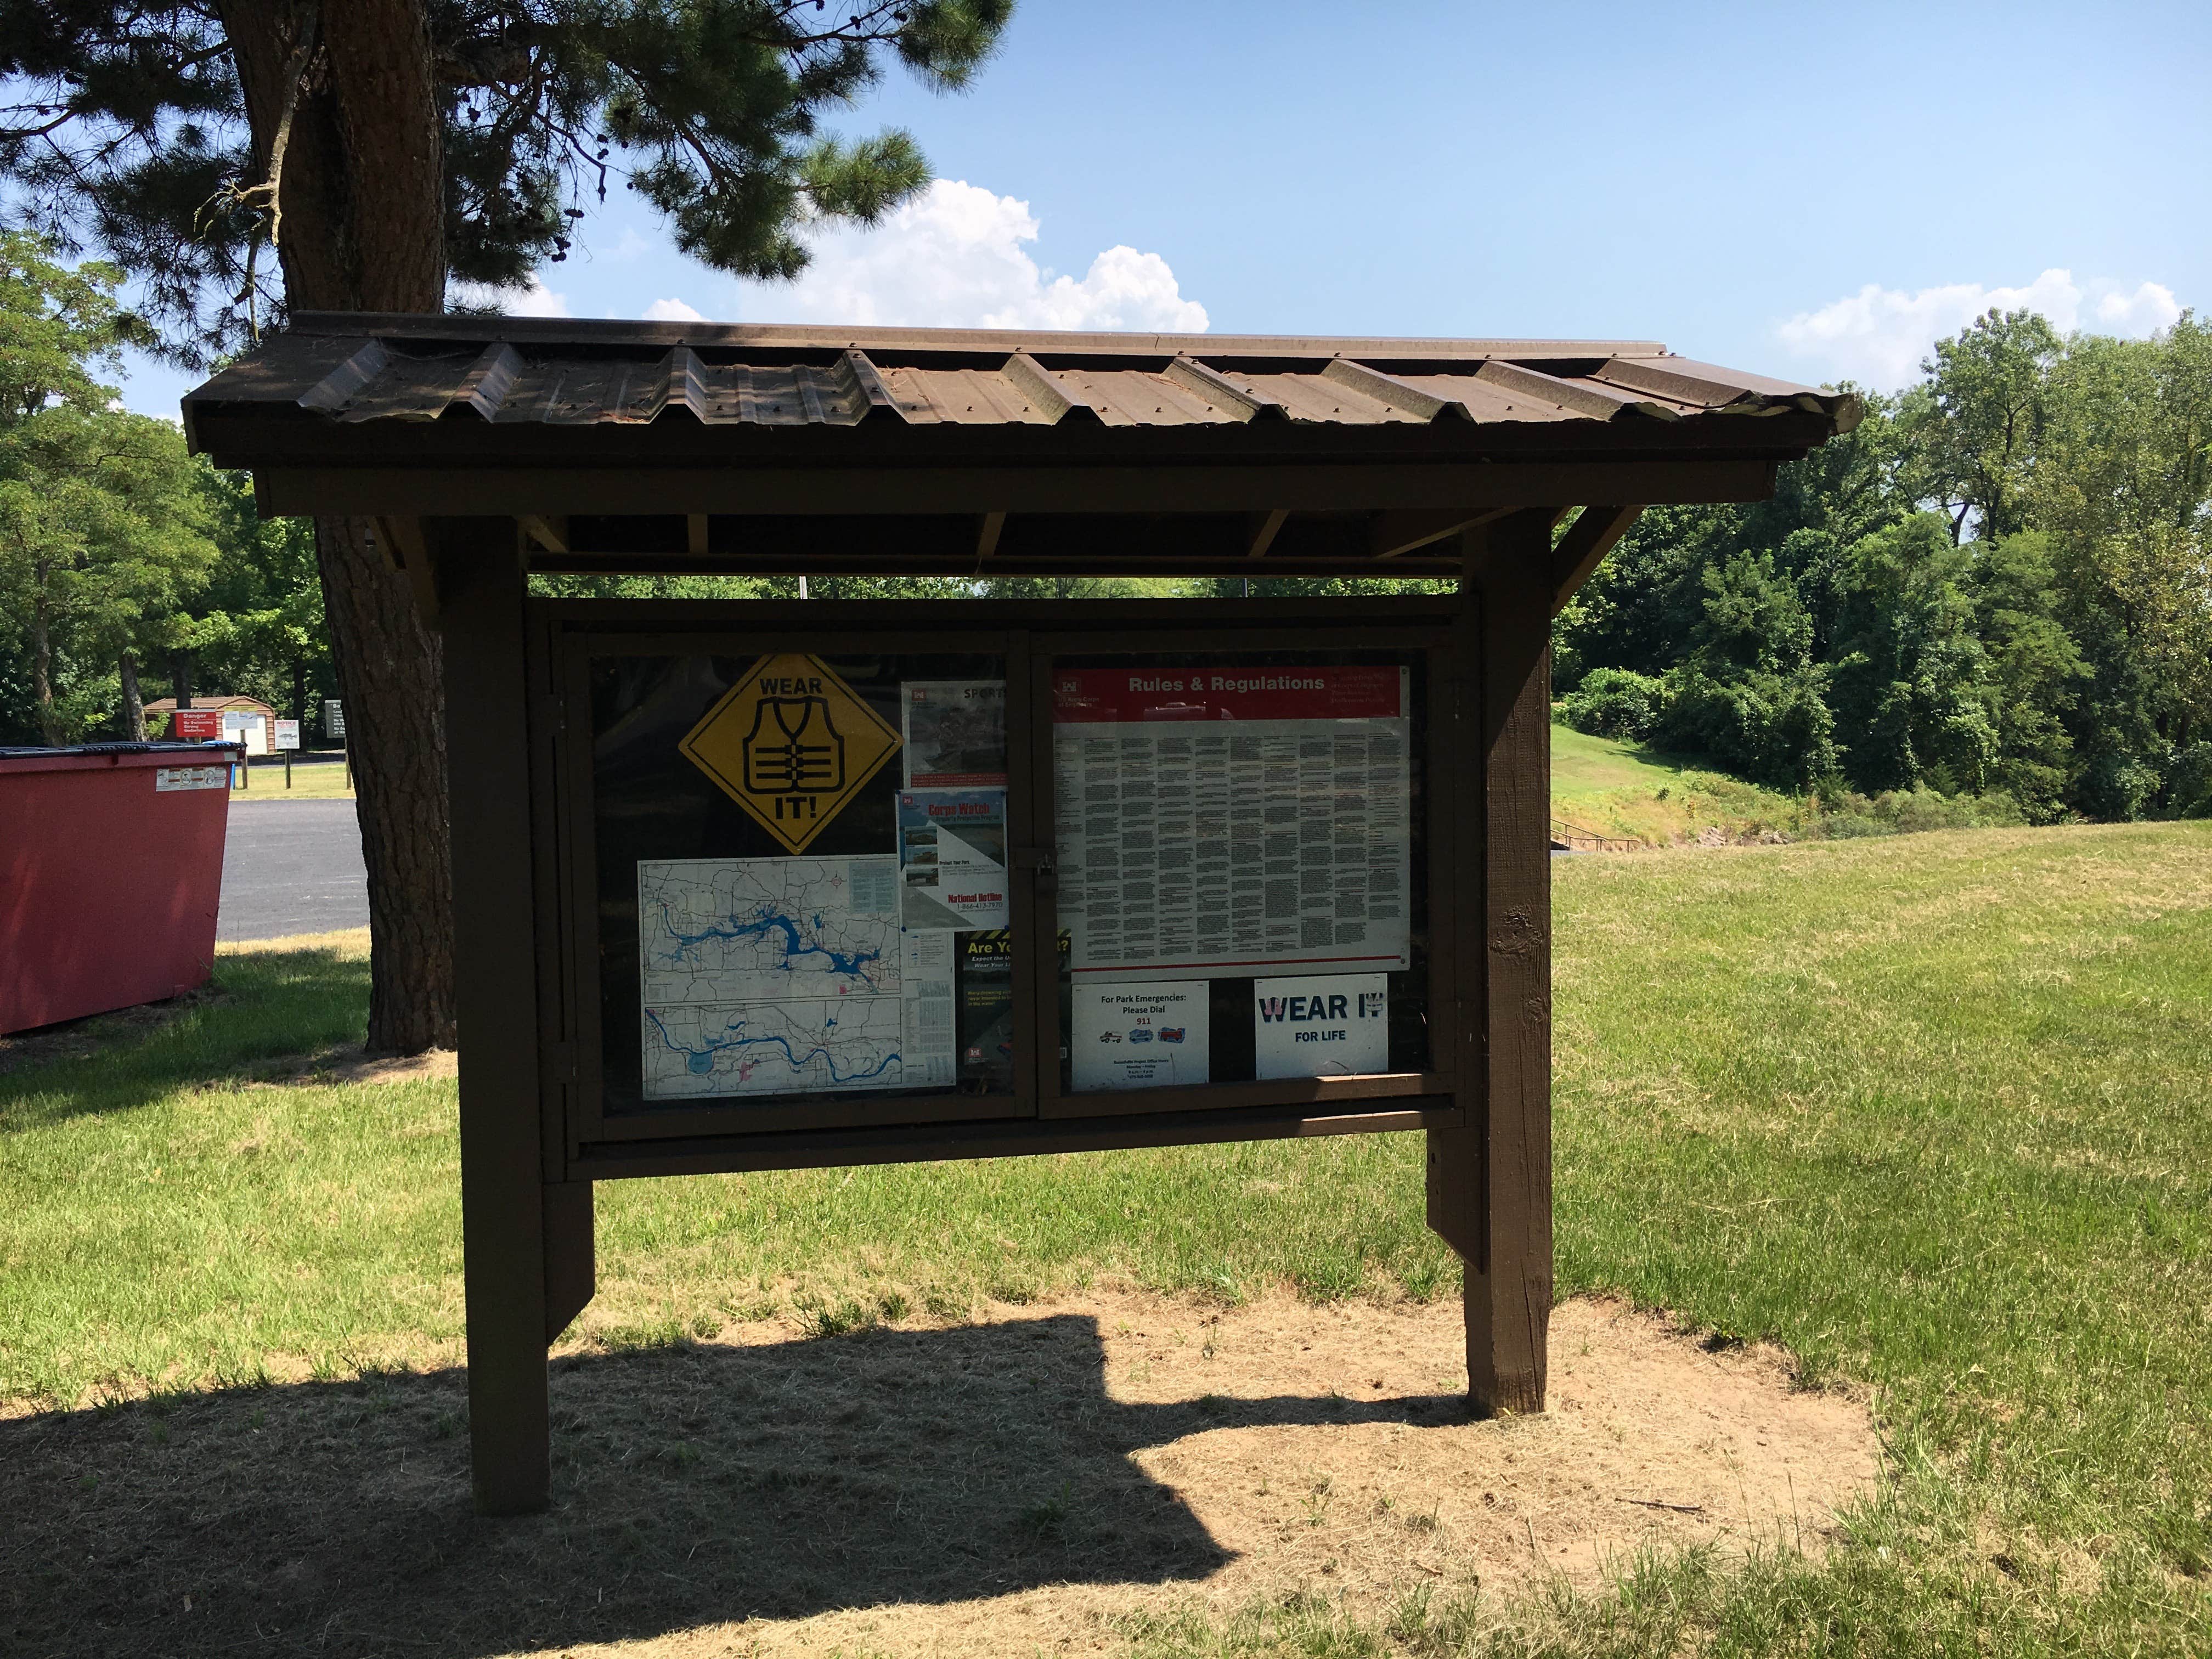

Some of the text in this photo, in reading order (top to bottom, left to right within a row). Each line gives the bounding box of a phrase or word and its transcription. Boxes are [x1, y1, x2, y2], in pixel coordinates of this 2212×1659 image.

[759, 677, 823, 695] WEAR
[1128, 675, 1325, 693] Rules & Regulations
[775, 796, 817, 820] IT!
[928, 804, 957, 817] Corps
[958, 803, 990, 815] Watch
[948, 893, 1002, 904] National Hotline
[967, 942, 993, 953] Are
[1135, 994, 1187, 1003] Emergencies:
[1259, 992, 1384, 1023] WEAR IT
[1295, 1030, 1346, 1042] FOR LIFE
